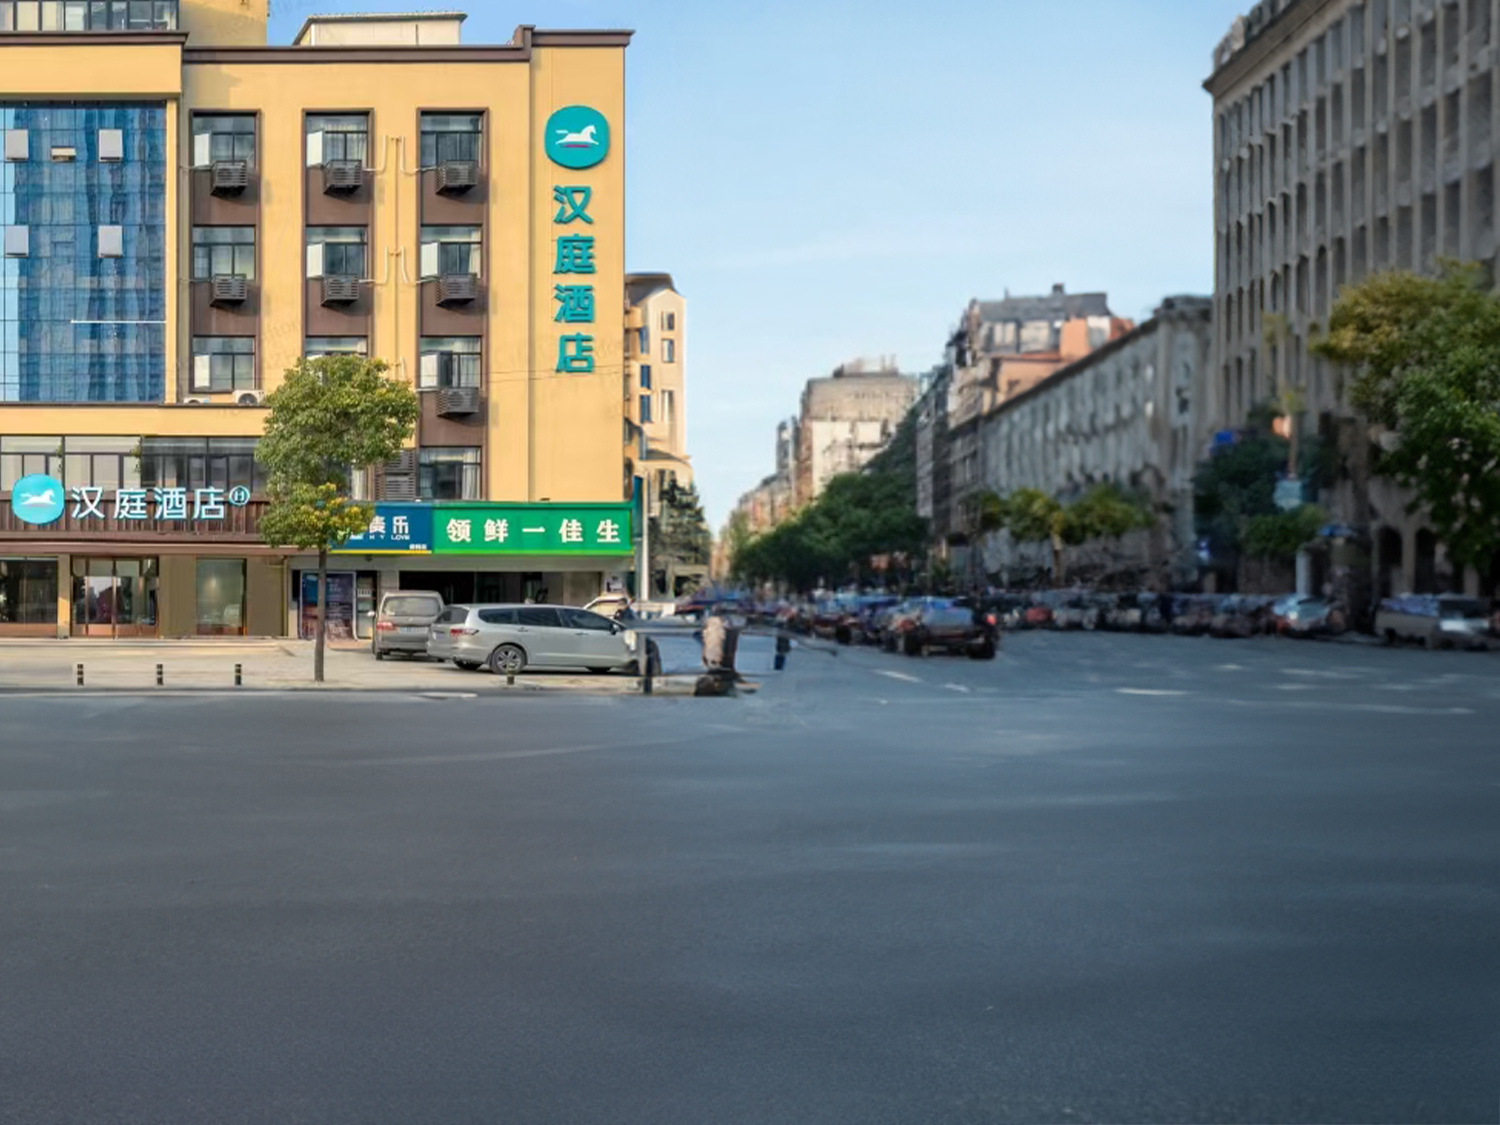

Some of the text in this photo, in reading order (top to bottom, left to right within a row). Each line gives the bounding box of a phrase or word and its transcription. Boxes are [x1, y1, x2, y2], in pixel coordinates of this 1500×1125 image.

[553, 185, 596, 373] 汉庭酒店
[71, 485, 225, 520] 汉庭酒店
[446, 518, 621, 543] 领鲜一佳生
